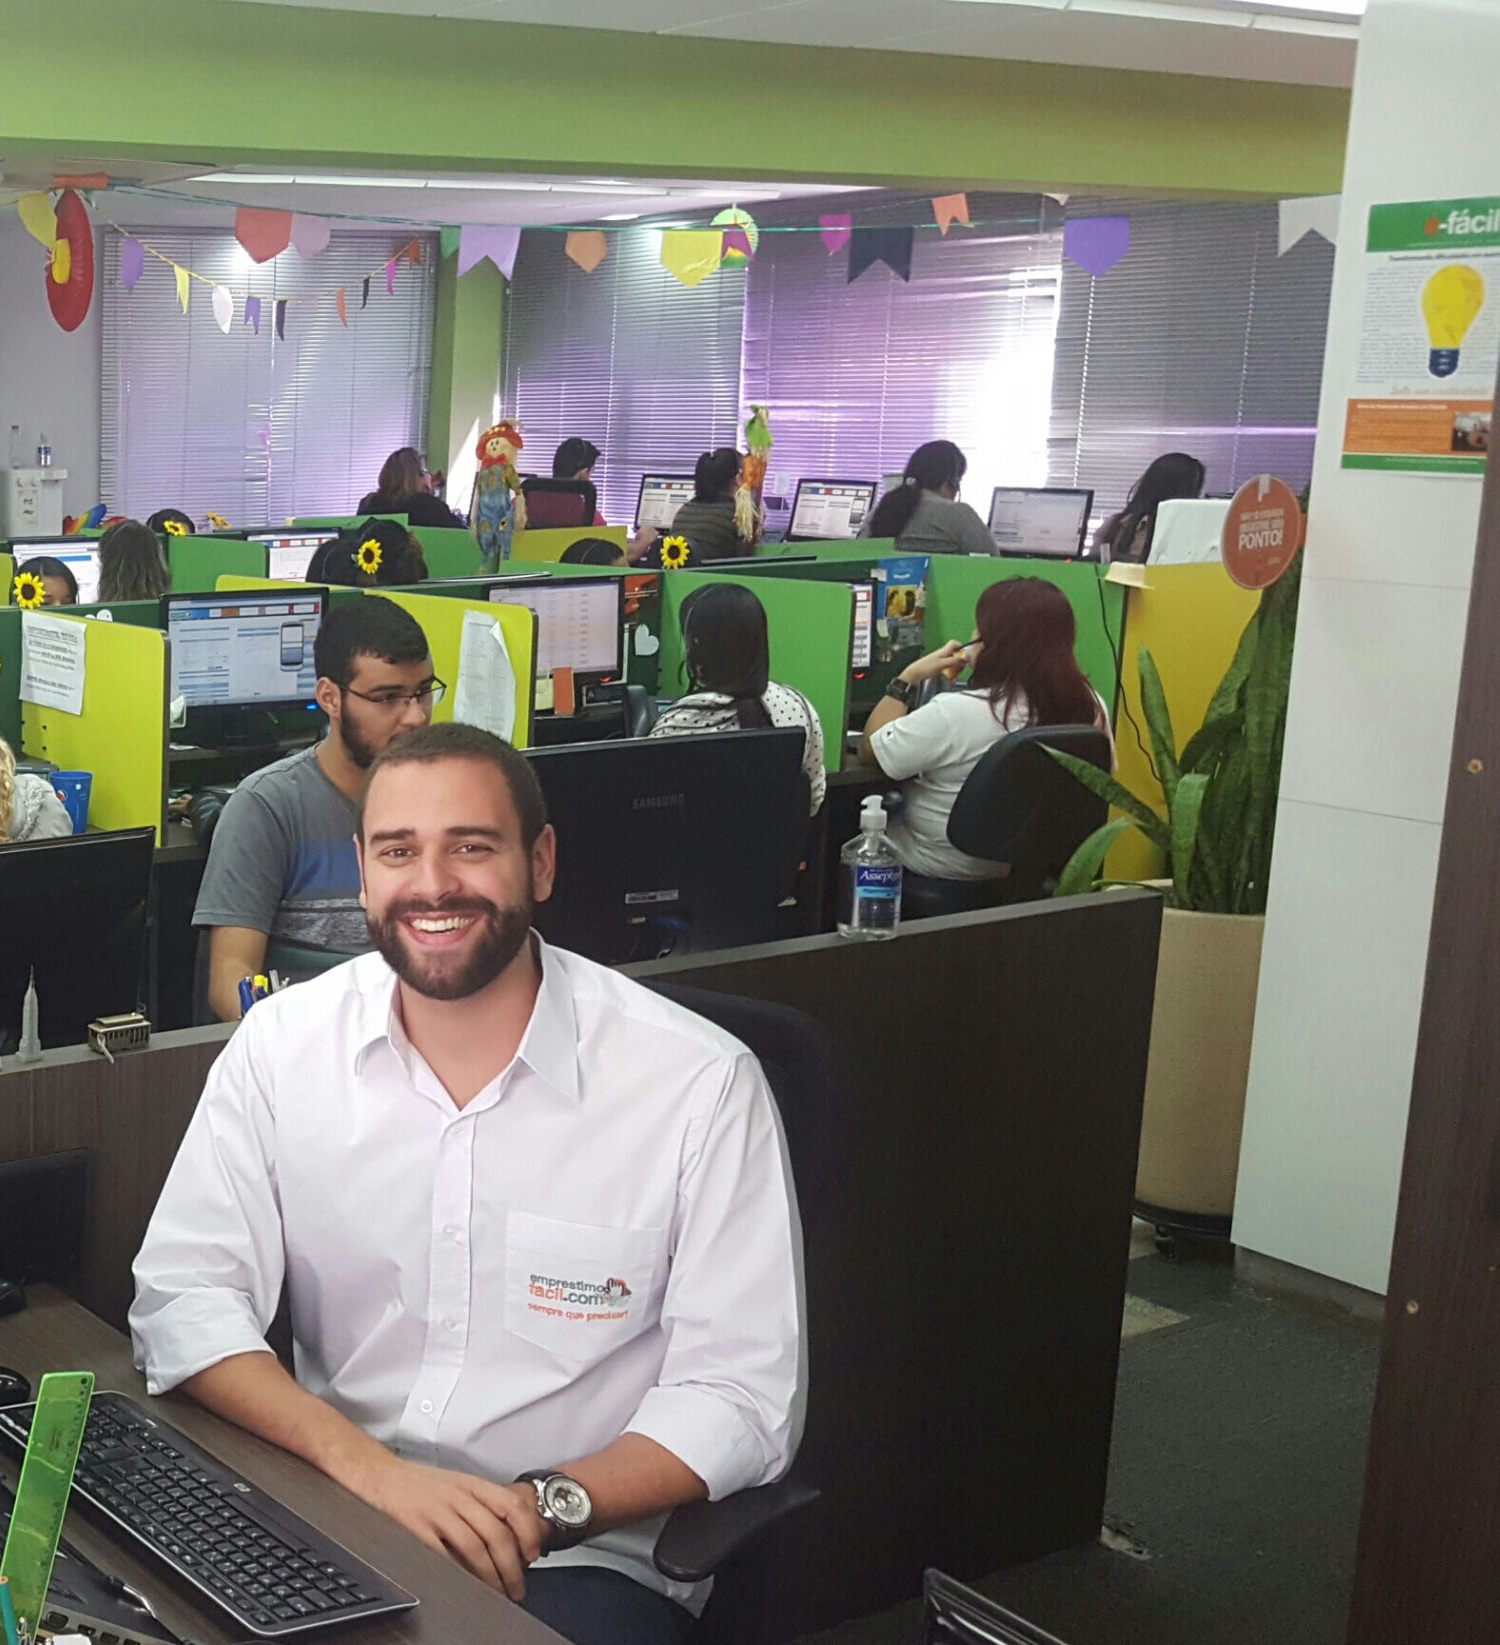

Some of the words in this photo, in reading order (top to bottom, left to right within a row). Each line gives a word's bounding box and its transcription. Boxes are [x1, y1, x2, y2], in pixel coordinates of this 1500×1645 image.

[1238, 528, 1284, 551] PONTO!
[529, 1273, 610, 1294] emprestimo
[527, 1302, 563, 1317] sempre
[565, 1309, 584, 1321] que
